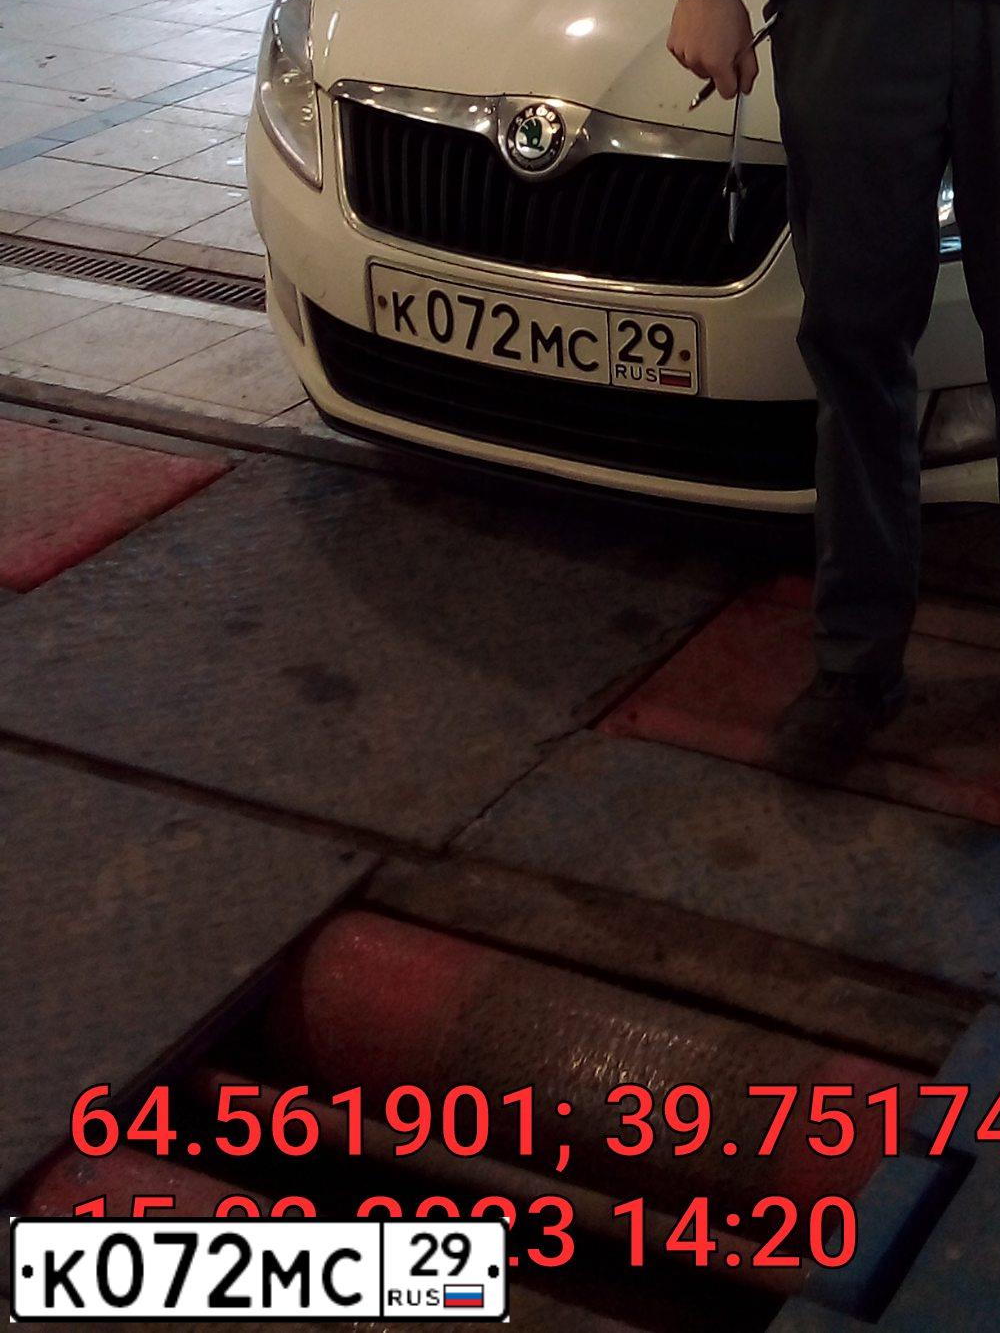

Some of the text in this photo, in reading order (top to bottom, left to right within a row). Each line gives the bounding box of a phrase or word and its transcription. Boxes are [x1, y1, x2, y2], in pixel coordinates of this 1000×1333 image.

[391, 289, 675, 373] К072МС 29
[614, 364, 658, 384] RUS
